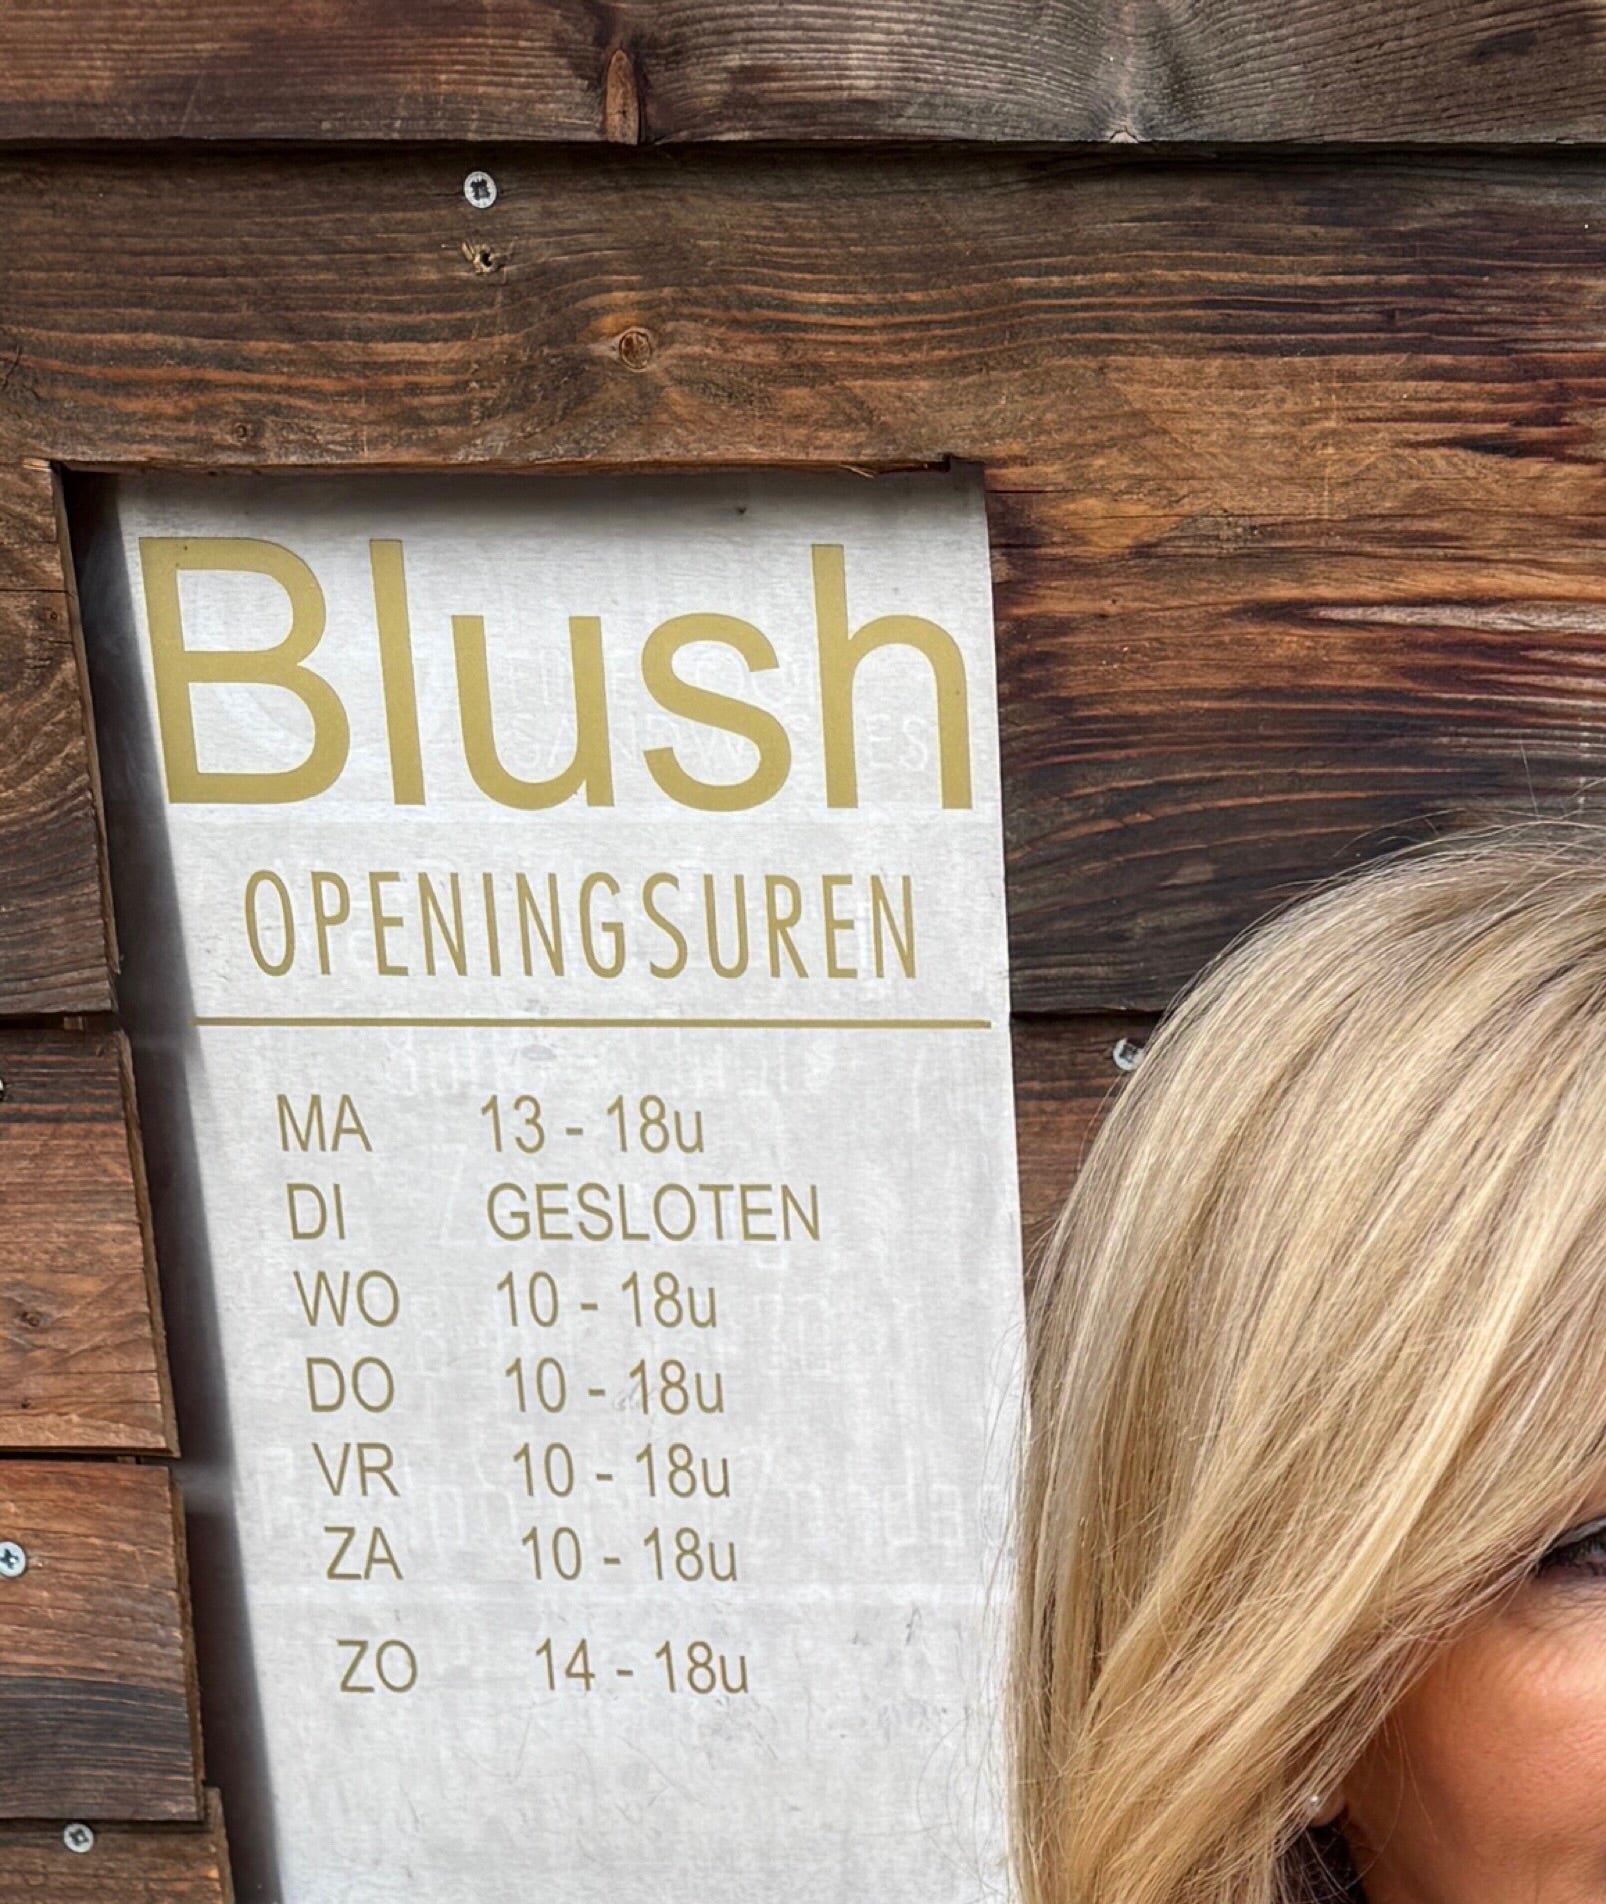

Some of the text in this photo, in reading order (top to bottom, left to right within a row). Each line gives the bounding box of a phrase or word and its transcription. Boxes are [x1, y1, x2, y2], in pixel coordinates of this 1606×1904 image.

[138, 536, 973, 813] Blush
[244, 870, 915, 979] OPENINGSUREN
[277, 1094, 372, 1151] MA
[287, 1183, 819, 1241] DI GESLOTEN
[294, 1270, 399, 1327] WO
[305, 1357, 394, 1412] DO
[312, 1441, 398, 1496] VR
[325, 1526, 402, 1580] ZA
[337, 1640, 417, 1693] ZO
